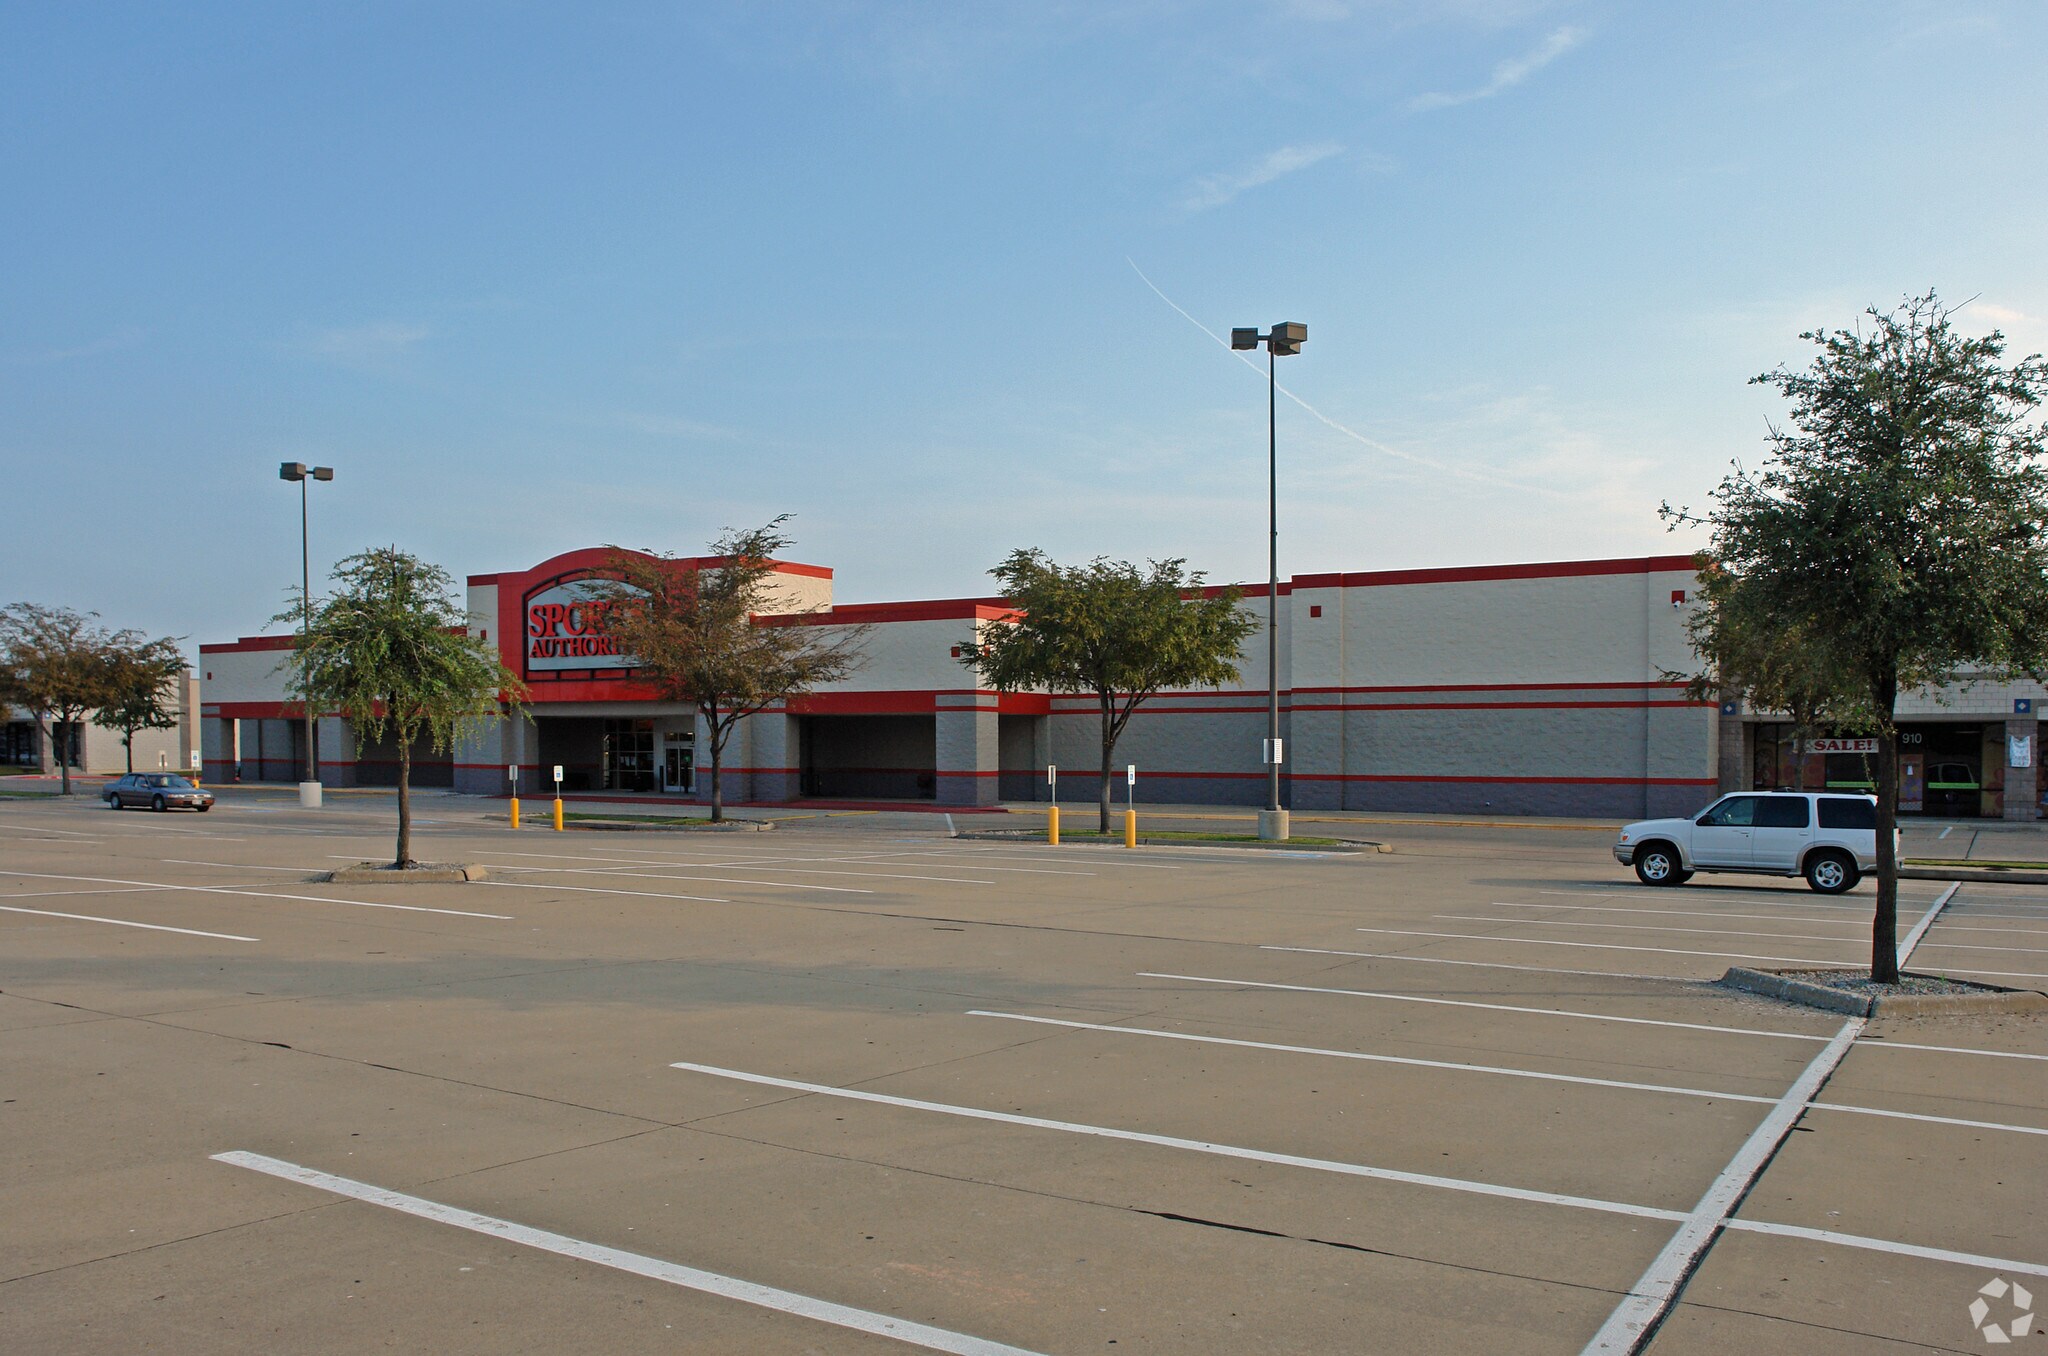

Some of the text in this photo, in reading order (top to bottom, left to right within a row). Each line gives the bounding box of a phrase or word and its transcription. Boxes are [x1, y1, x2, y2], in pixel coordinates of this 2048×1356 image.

[529, 599, 648, 637] SPOR
[529, 635, 643, 658] AUTHORI
[1814, 740, 1873, 751] SALE!
[1902, 733, 1922, 744] 910
